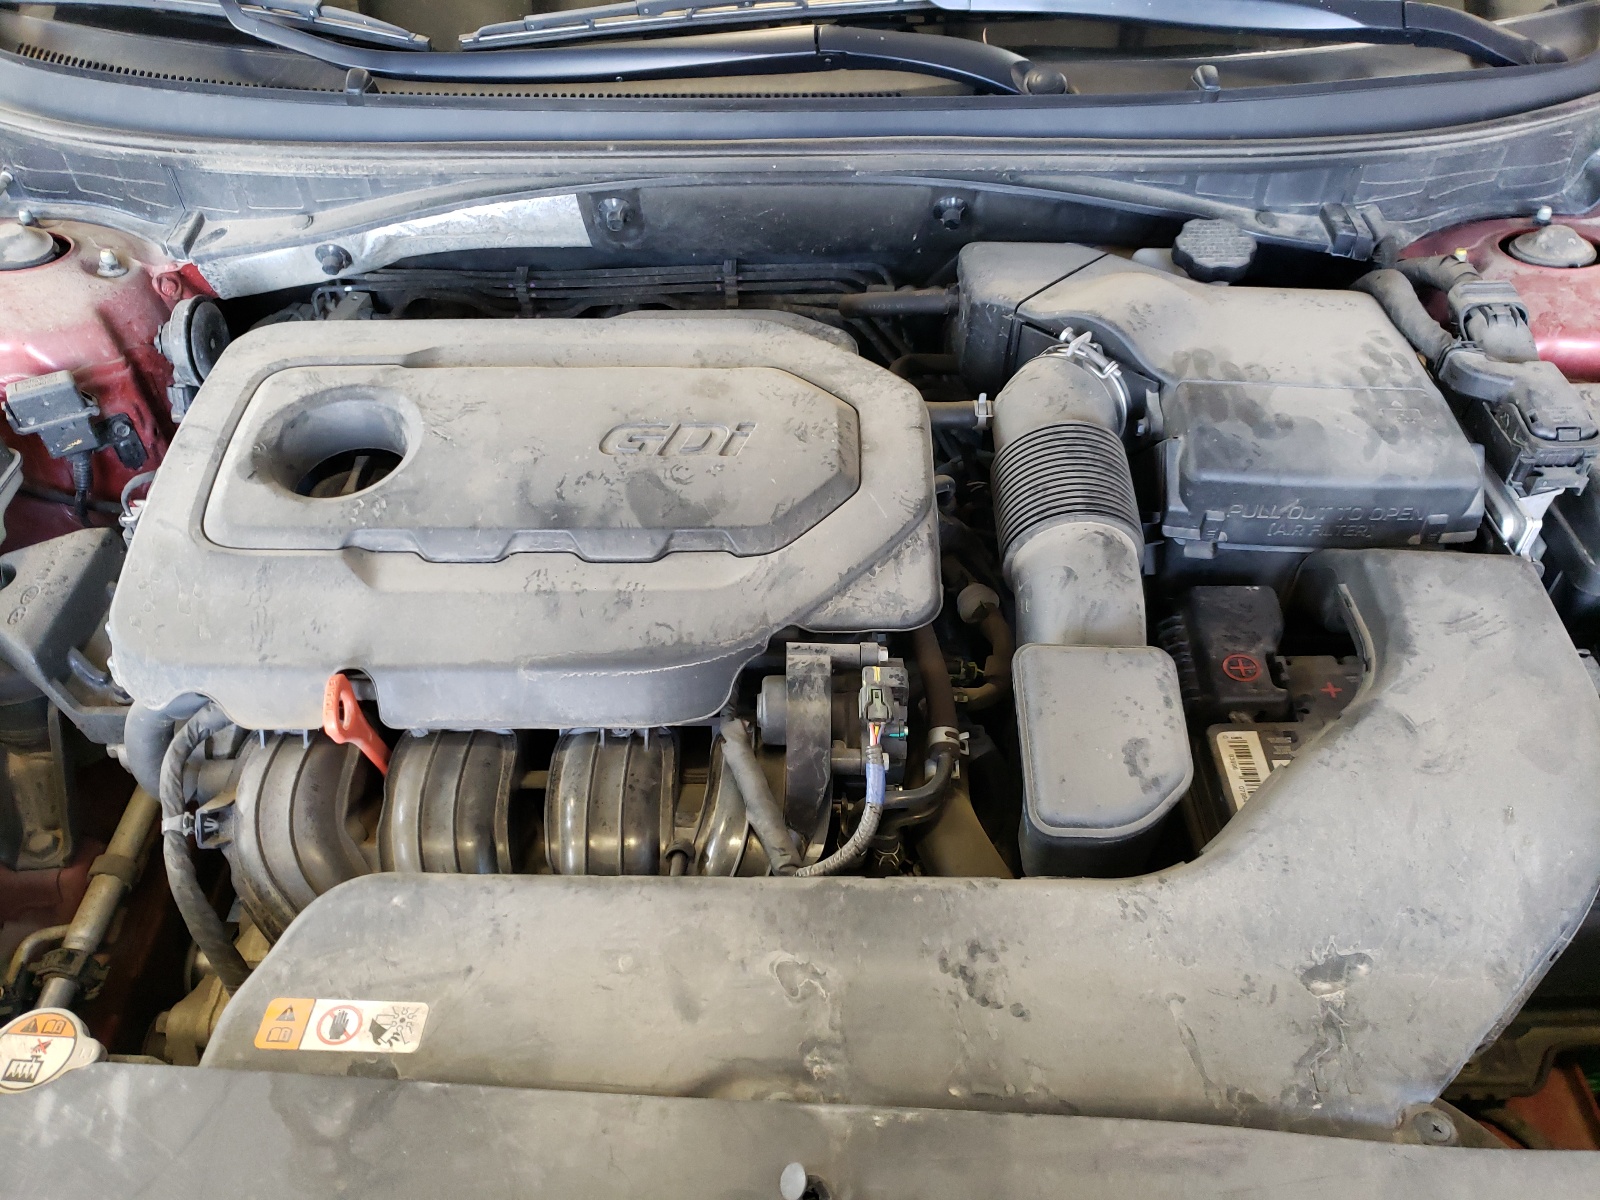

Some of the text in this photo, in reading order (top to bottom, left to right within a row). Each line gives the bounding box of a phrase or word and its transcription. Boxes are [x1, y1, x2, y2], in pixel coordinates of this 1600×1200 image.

[1226, 504, 1425, 521] PULL OUT TO OPEN
